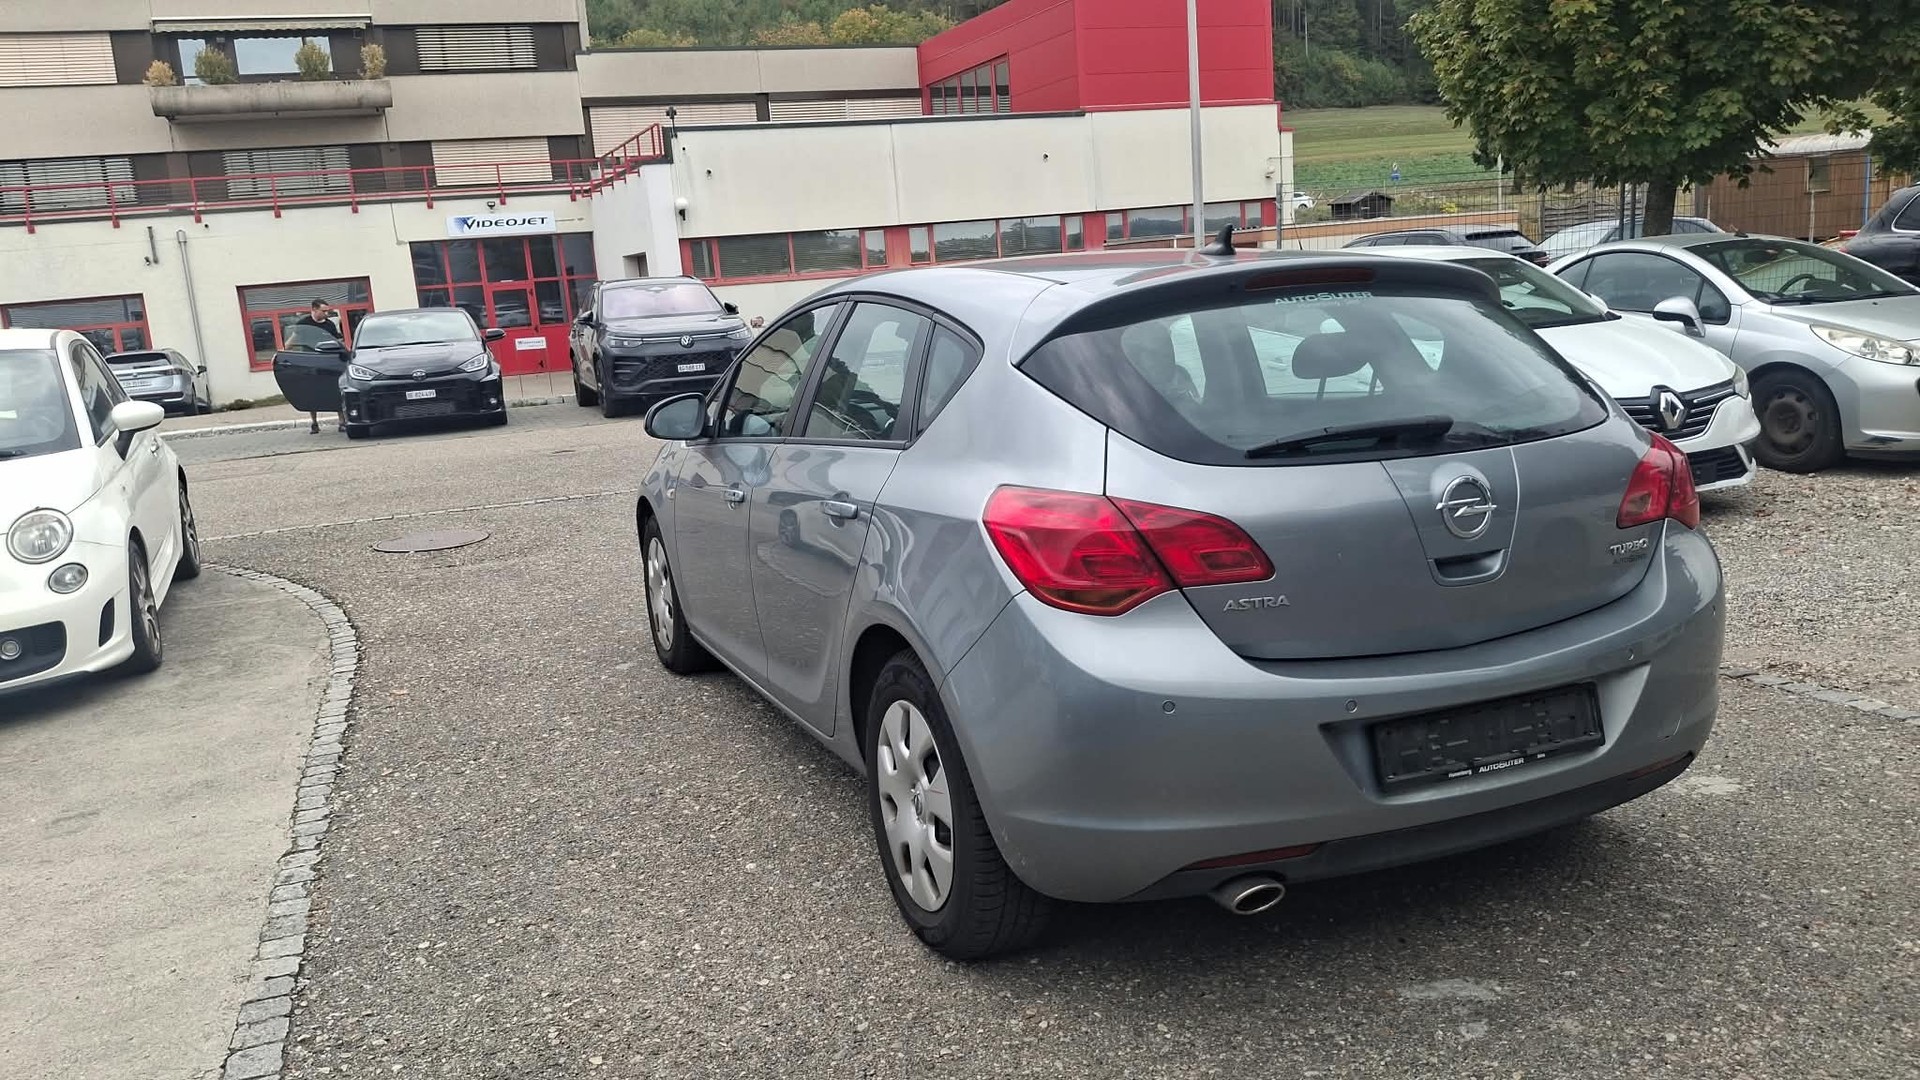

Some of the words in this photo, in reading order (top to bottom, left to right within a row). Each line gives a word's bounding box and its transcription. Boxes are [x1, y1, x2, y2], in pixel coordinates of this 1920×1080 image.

[464, 217, 548, 230] VIDEOJET
[1610, 538, 1649, 554] TURBO
[1223, 595, 1291, 612] ASTRA
